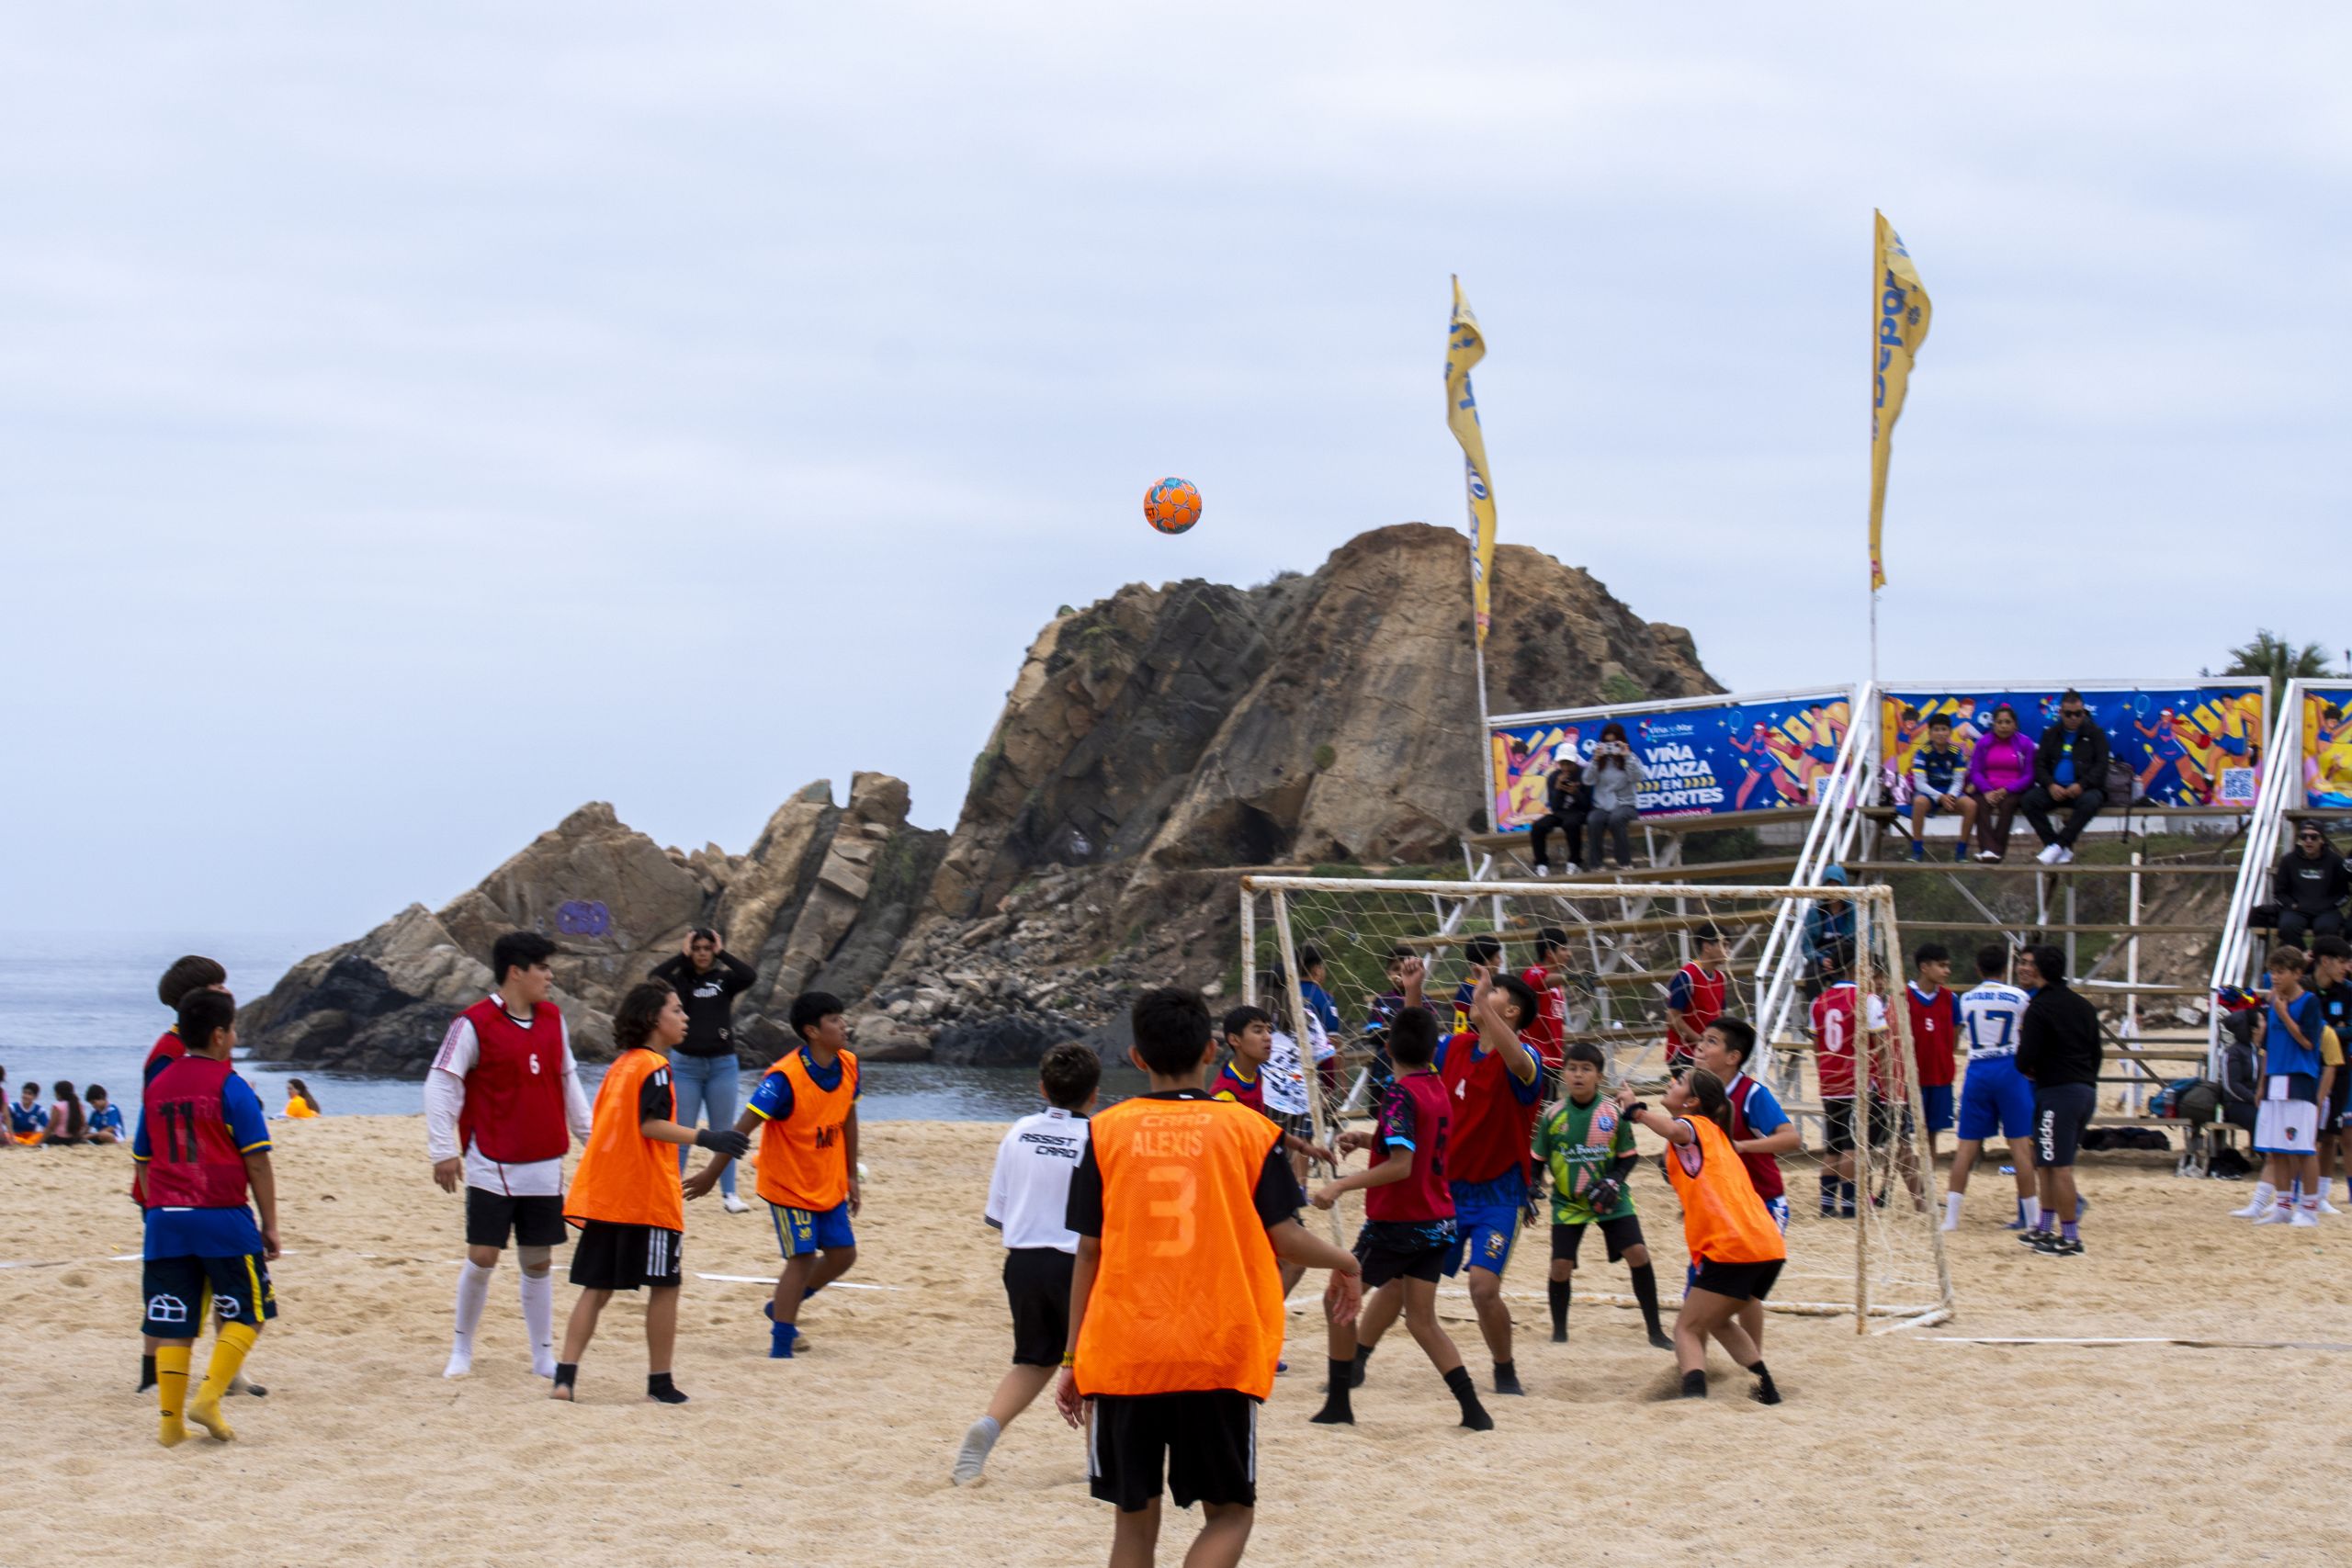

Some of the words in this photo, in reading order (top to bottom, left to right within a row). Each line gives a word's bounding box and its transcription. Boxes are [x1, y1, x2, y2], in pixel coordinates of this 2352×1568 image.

[1644, 742, 1696, 763] VIÑA
[1642, 760, 1713, 780] VANZA
[1661, 779, 1683, 790] EN
[1634, 787, 1724, 808] EPORTES
[1824, 1008, 1844, 1053] 6
[1925, 1017, 1935, 1032] 5
[1968, 1010, 2014, 1050] 17
[528, 1053, 540, 1075] 6
[1454, 1077, 1466, 1100] 4
[1140, 1113, 1213, 1127] CARD
[158, 1101, 198, 1163] 11
[1019, 1133, 1078, 1146] ASSIST
[2038, 1110, 2055, 1161] adidas
[1035, 1145, 1079, 1159] CARD
[1131, 1129, 1204, 1157] ALEXIS
[791, 1209, 812, 1226] 10
[1148, 1165, 1197, 1258] 3
